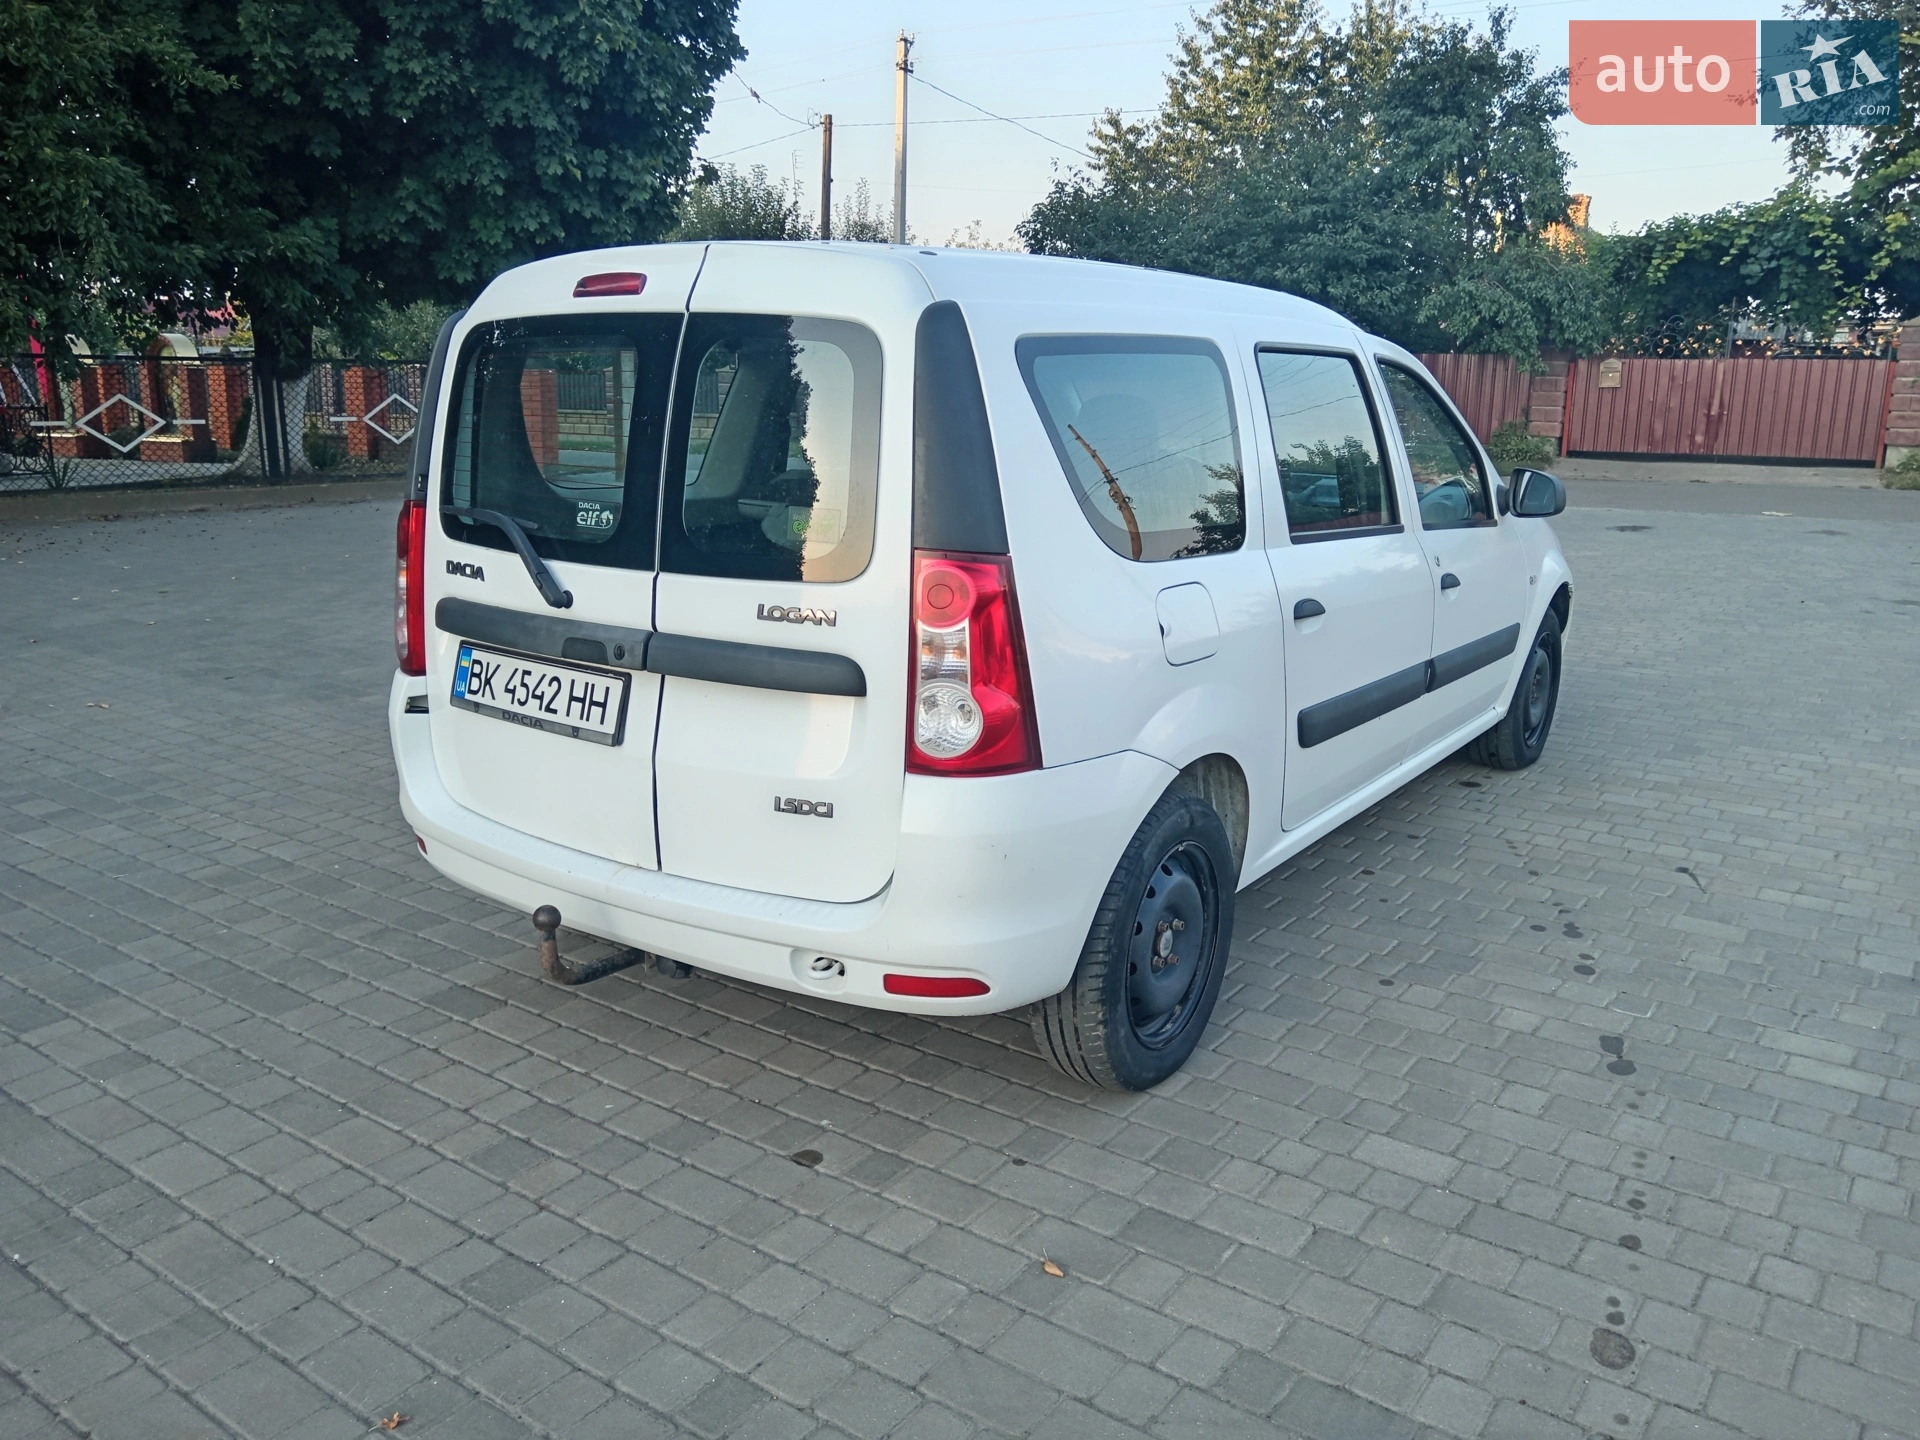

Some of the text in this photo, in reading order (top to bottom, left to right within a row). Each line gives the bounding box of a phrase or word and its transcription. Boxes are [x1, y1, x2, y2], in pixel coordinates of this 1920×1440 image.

[578, 501, 600, 510] DACIA
[576, 510, 600, 526] elf
[446, 560, 485, 582] DACIA
[757, 603, 837, 627] LOGAN
[456, 680, 465, 693] UA
[467, 658, 610, 725] BK 4542 HH
[502, 710, 544, 730] DACIA
